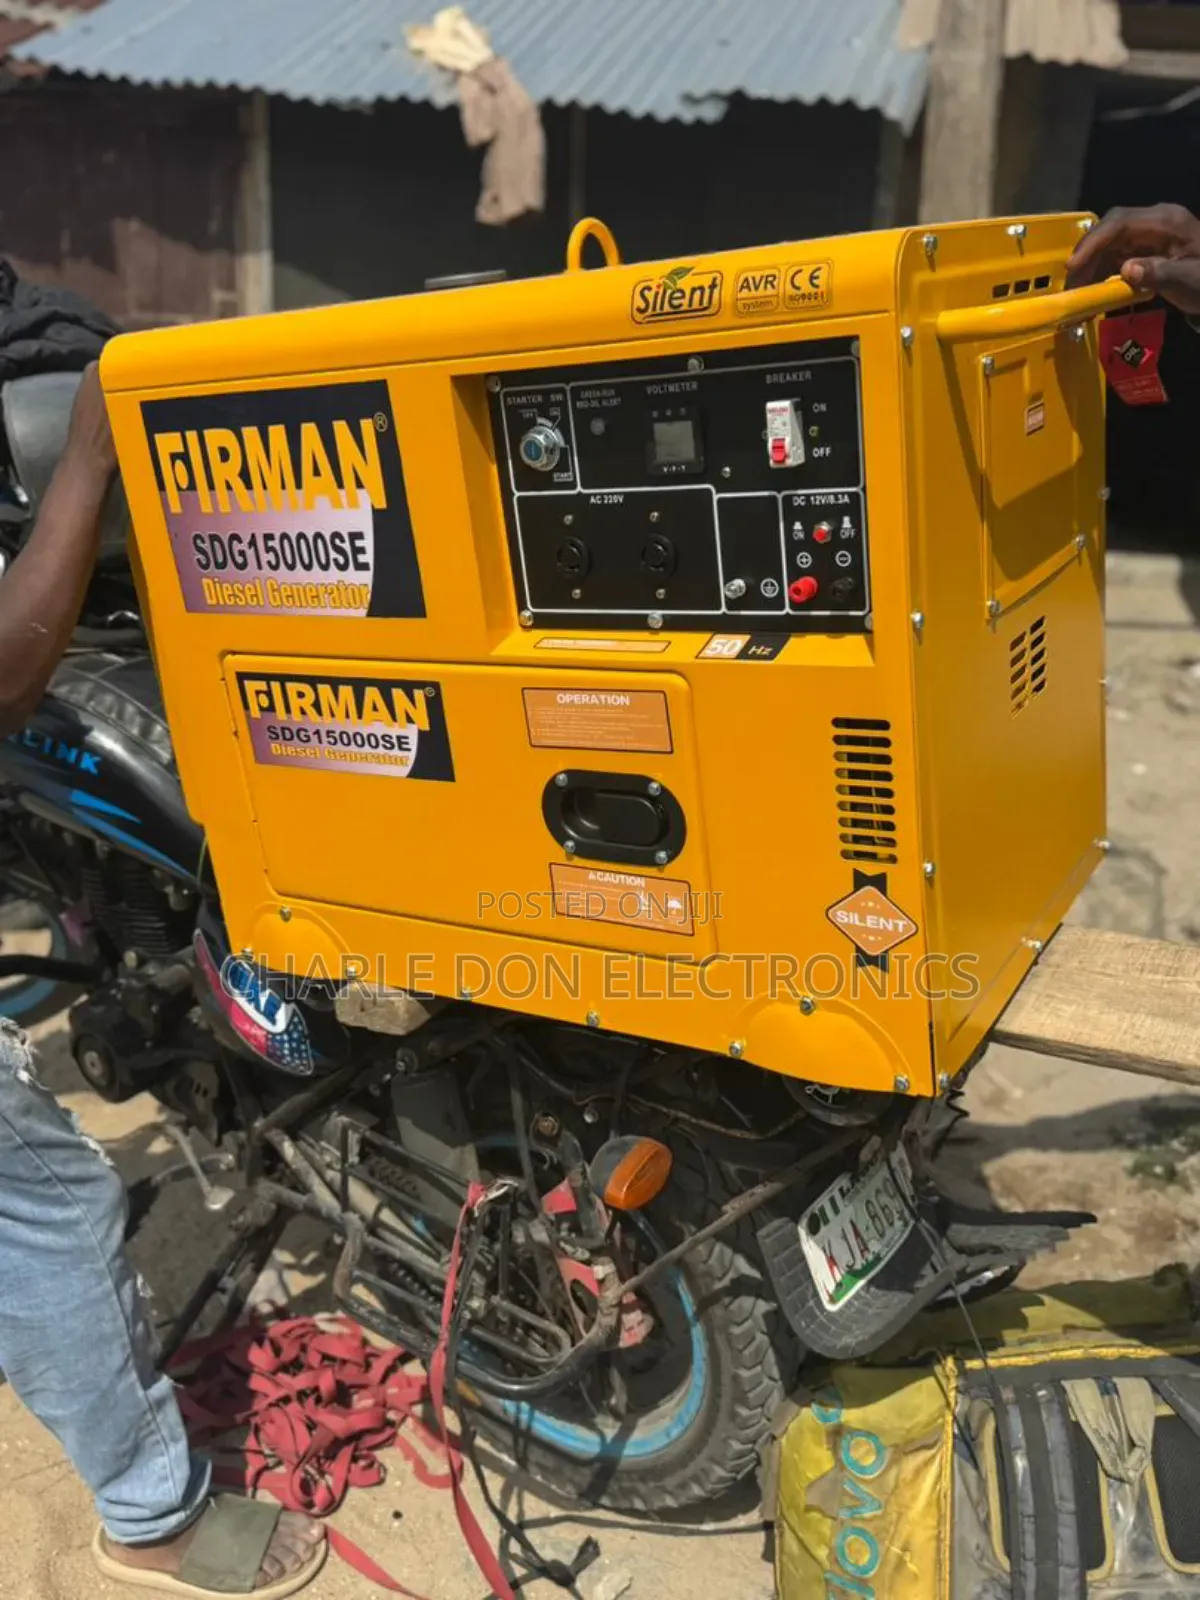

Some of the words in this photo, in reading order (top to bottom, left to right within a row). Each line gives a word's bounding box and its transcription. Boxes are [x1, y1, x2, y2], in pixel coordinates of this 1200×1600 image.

[738, 273, 778, 293] AVR
[790, 266, 823, 291] CE
[635, 276, 719, 315] Silent
[765, 370, 813, 385] BREAKER
[646, 381, 698, 395] VOLTMETER
[506, 394, 543, 406] STARTER
[812, 402, 827, 413] ON
[812, 446, 832, 458] OFF
[154, 418, 388, 514] FIRMAN
[589, 494, 602, 504] AC
[603, 494, 624, 504] 220V
[792, 495, 806, 506] DC
[792, 530, 805, 541] ON
[840, 528, 856, 539] OFF
[191, 531, 371, 572] SDG15000SE
[202, 578, 265, 607] Diesel
[266, 578, 371, 610] Generator
[703, 639, 742, 655] 50
[748, 645, 773, 656] Hz
[243, 680, 431, 731] FIRMAN
[556, 693, 631, 706] OPERATION
[266, 725, 412, 752] SDG15000SE
[270, 743, 321, 759] Diesel
[596, 872, 646, 888] CAUTION
[835, 909, 908, 933] SILENT
